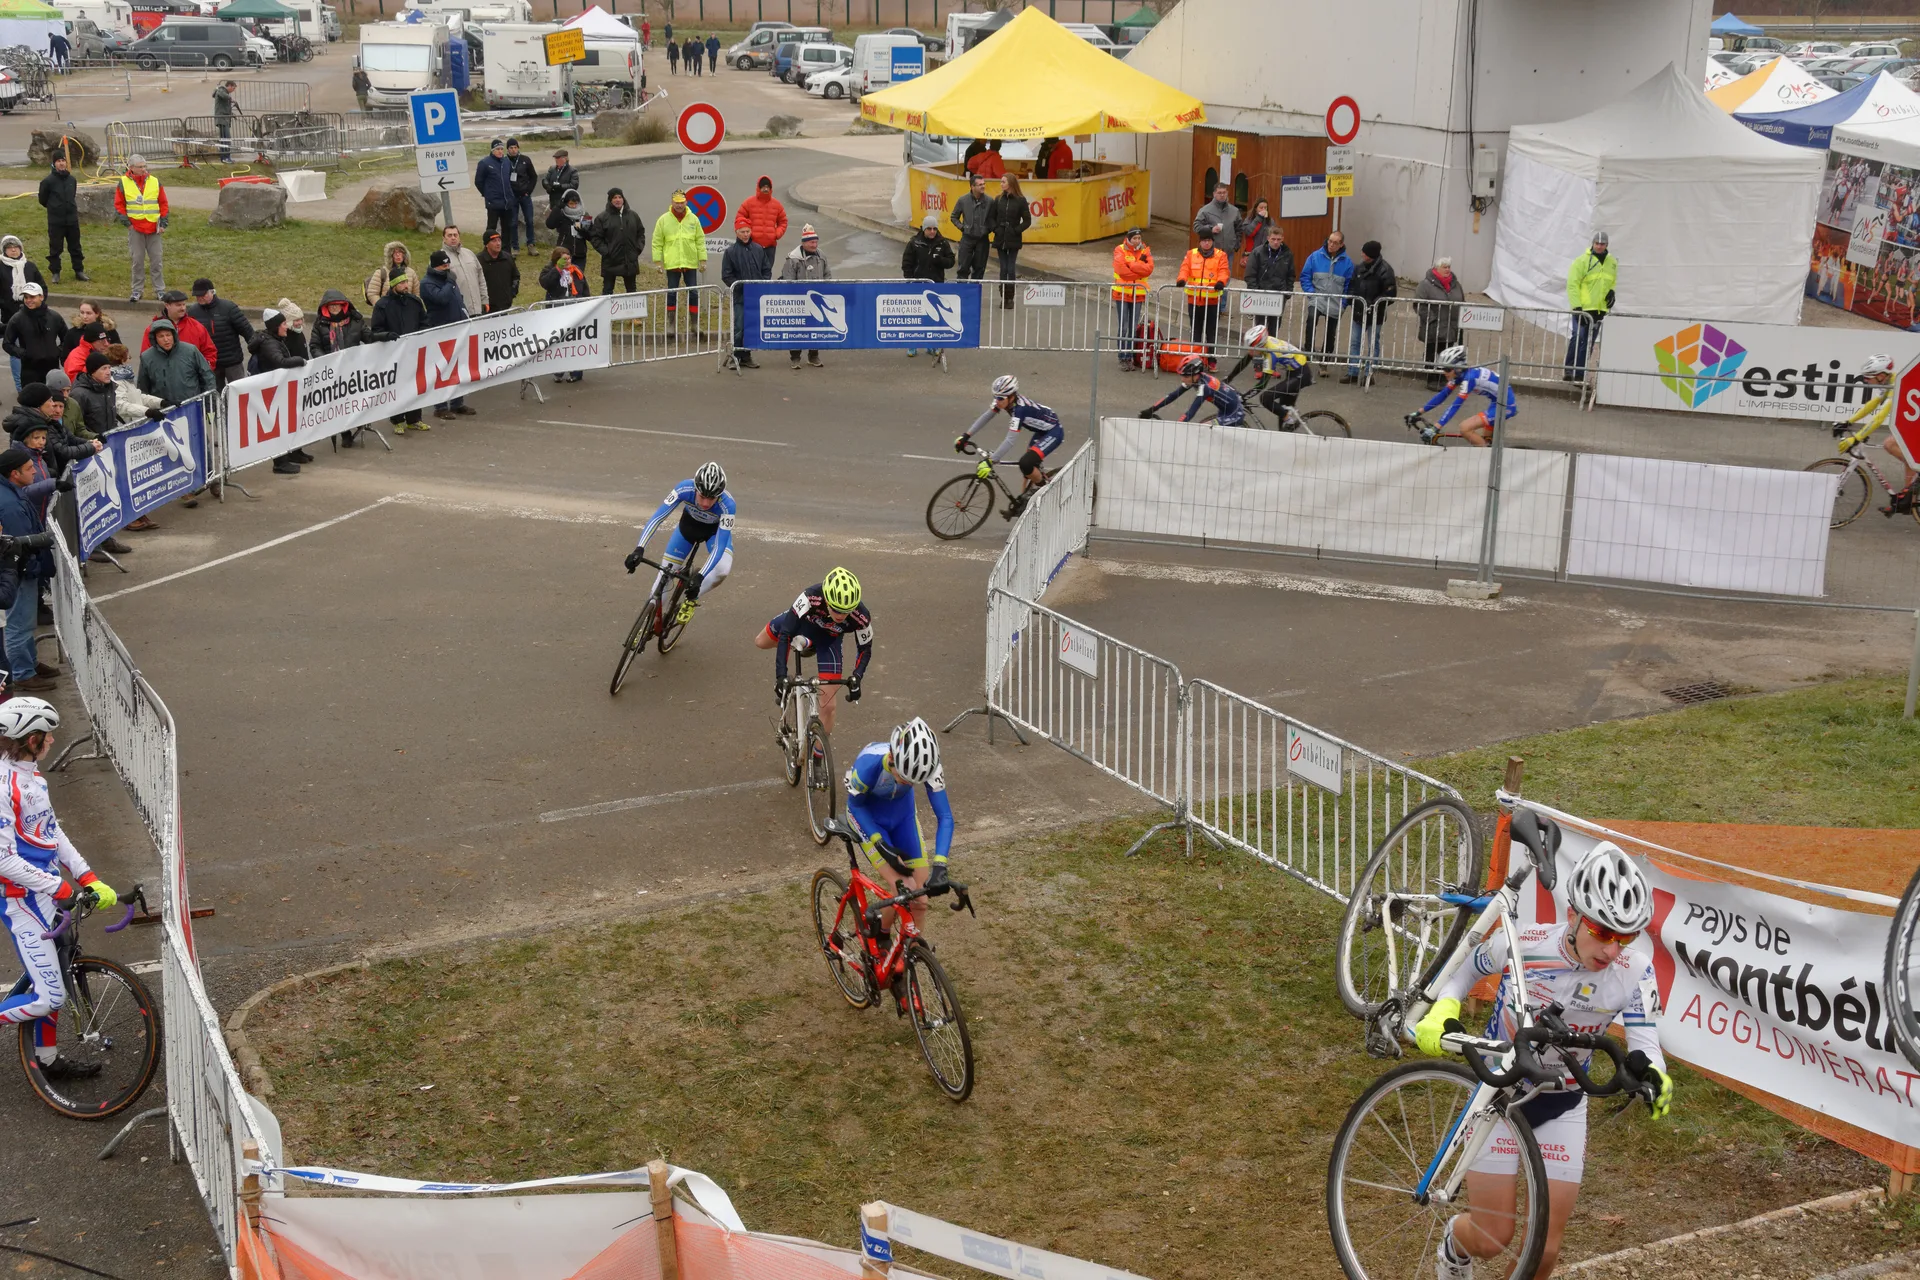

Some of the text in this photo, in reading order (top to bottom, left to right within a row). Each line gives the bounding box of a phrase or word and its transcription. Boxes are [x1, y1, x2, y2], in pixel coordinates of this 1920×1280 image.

[423, 102, 446, 136] P
[1175, 107, 1203, 125] METEOR
[425, 149, 456, 159] Réservé
[1217, 141, 1237, 155] CAISSE
[920, 191, 948, 212] METEOR
[1099, 187, 1137, 218] METEOR
[766, 298, 806, 306] FÉDÉRATION
[882, 298, 922, 306] FÉDÉRATION
[772, 318, 806, 326] CYCLISME
[483, 323, 524, 344] Pays de
[484, 319, 598, 363] Montbéliard
[303, 365, 334, 389] Pays de
[302, 362, 398, 412] Montbéliard
[300, 389, 397, 430] AGGLOMÉRATION
[1739, 399, 1831, 414] L'IMPRESSION
[130, 436, 166, 453] FÉDÉRATION
[130, 446, 165, 466] FRANÇAISE
[136, 462, 163, 482] CYCLISME
[720, 518, 734, 528] 130
[795, 598, 806, 612] 94
[1683, 902, 1791, 955] Pays de
[1496, 1137, 1518, 1146] CYCL
[1539, 1143, 1566, 1152] YCLES
[1541, 1153, 1570, 1162] SELLO
